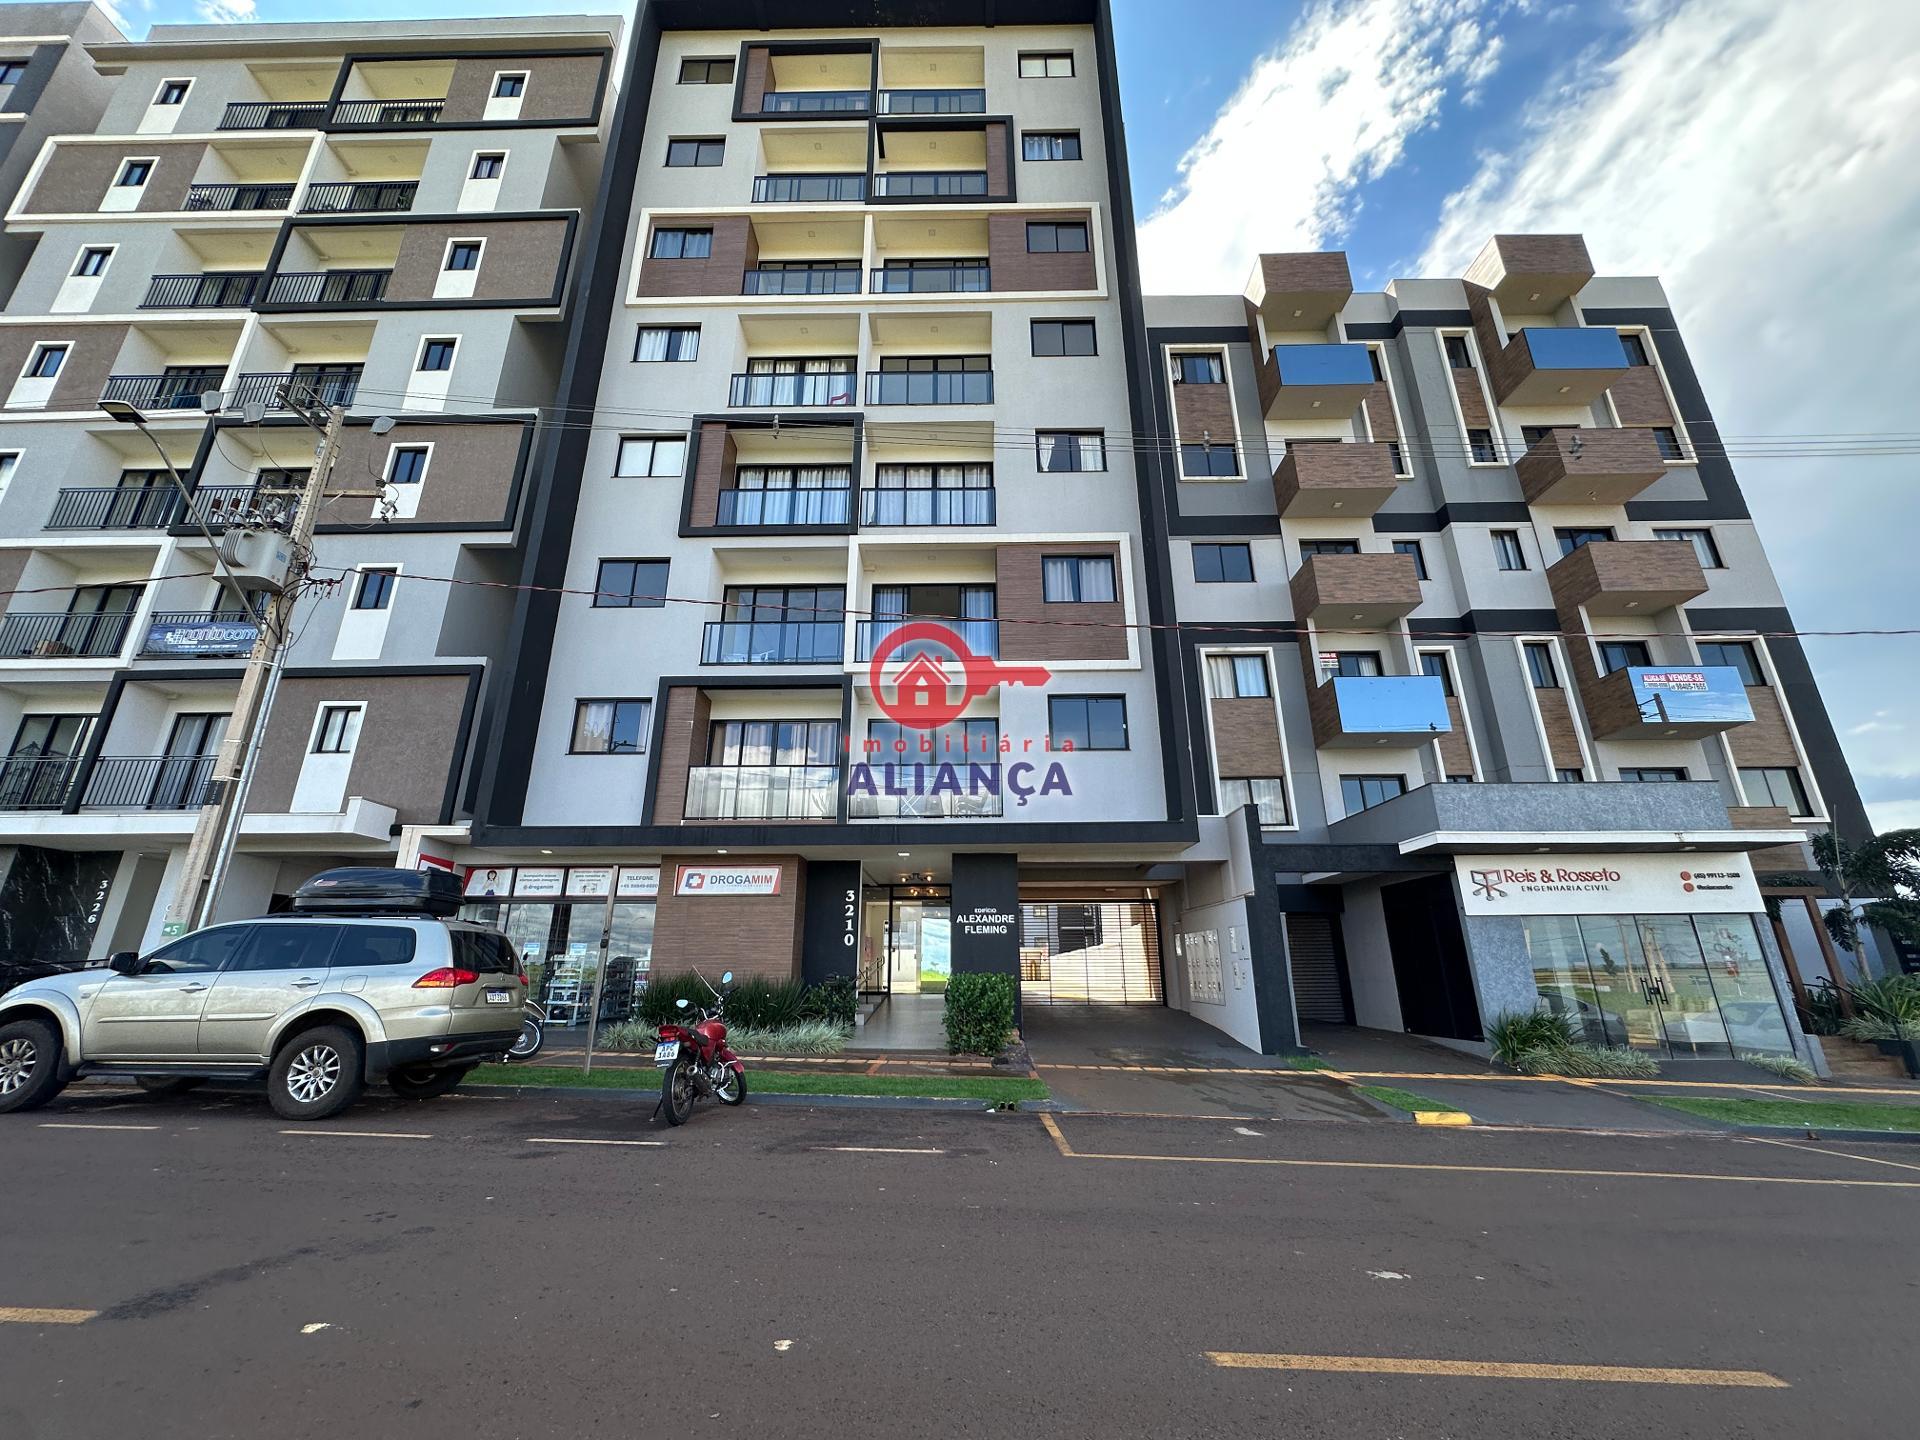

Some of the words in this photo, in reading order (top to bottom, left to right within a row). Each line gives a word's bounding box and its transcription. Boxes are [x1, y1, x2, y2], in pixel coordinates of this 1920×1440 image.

[1667, 673, 1705, 682] VENDE-SE
[710, 875, 773, 885] DROGAMIM
[1503, 868, 1537, 883] Reis
[1540, 869, 1555, 883] &
[1556, 868, 1621, 883] Rosseto
[1584, 884, 1610, 892] CIVIL
[87, 880, 109, 924] 3226
[843, 889, 855, 947] 3210
[956, 914, 1015, 924] ALEXANDRE
[170, 925, 180, 935] 5
[964, 925, 1008, 935] FLEMING
